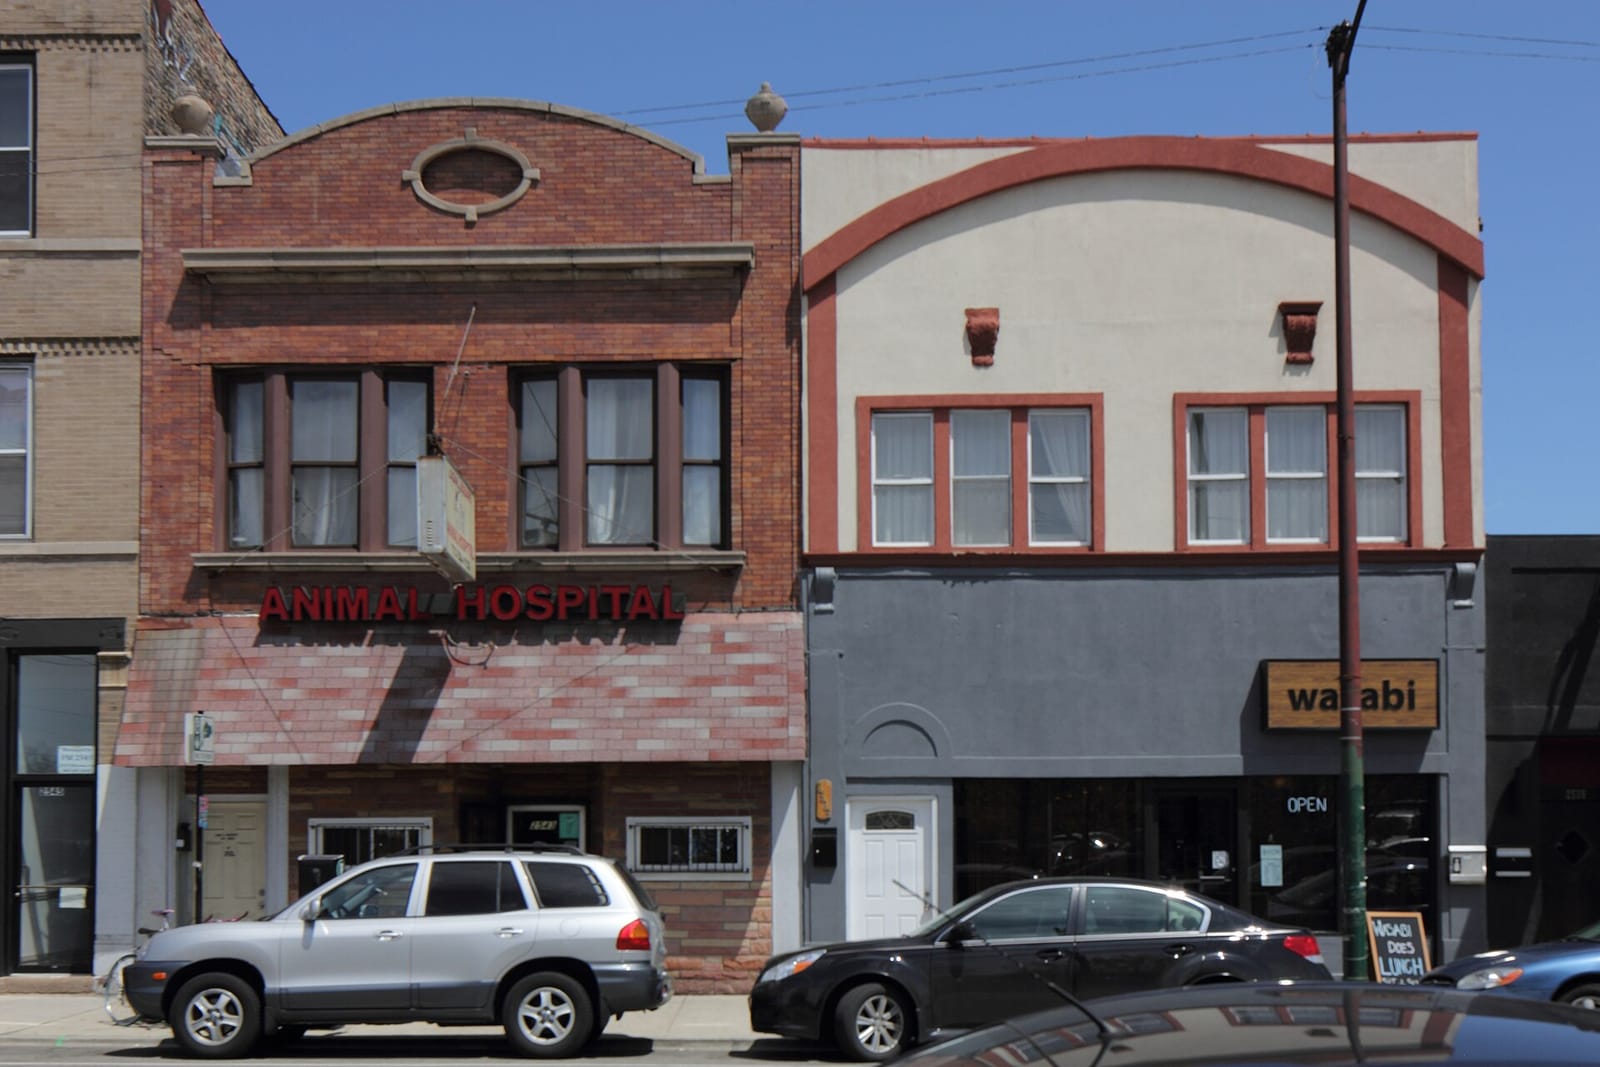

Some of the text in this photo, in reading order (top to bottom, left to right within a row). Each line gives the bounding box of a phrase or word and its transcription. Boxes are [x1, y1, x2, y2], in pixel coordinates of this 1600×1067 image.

[259, 584, 686, 621] ANIMAL HOSPITAL
[1288, 679, 1416, 711] waabi
[1287, 796, 1328, 813] OPEN
[1387, 940, 1415, 955] DOES
[1379, 956, 1424, 977] LUNCH
